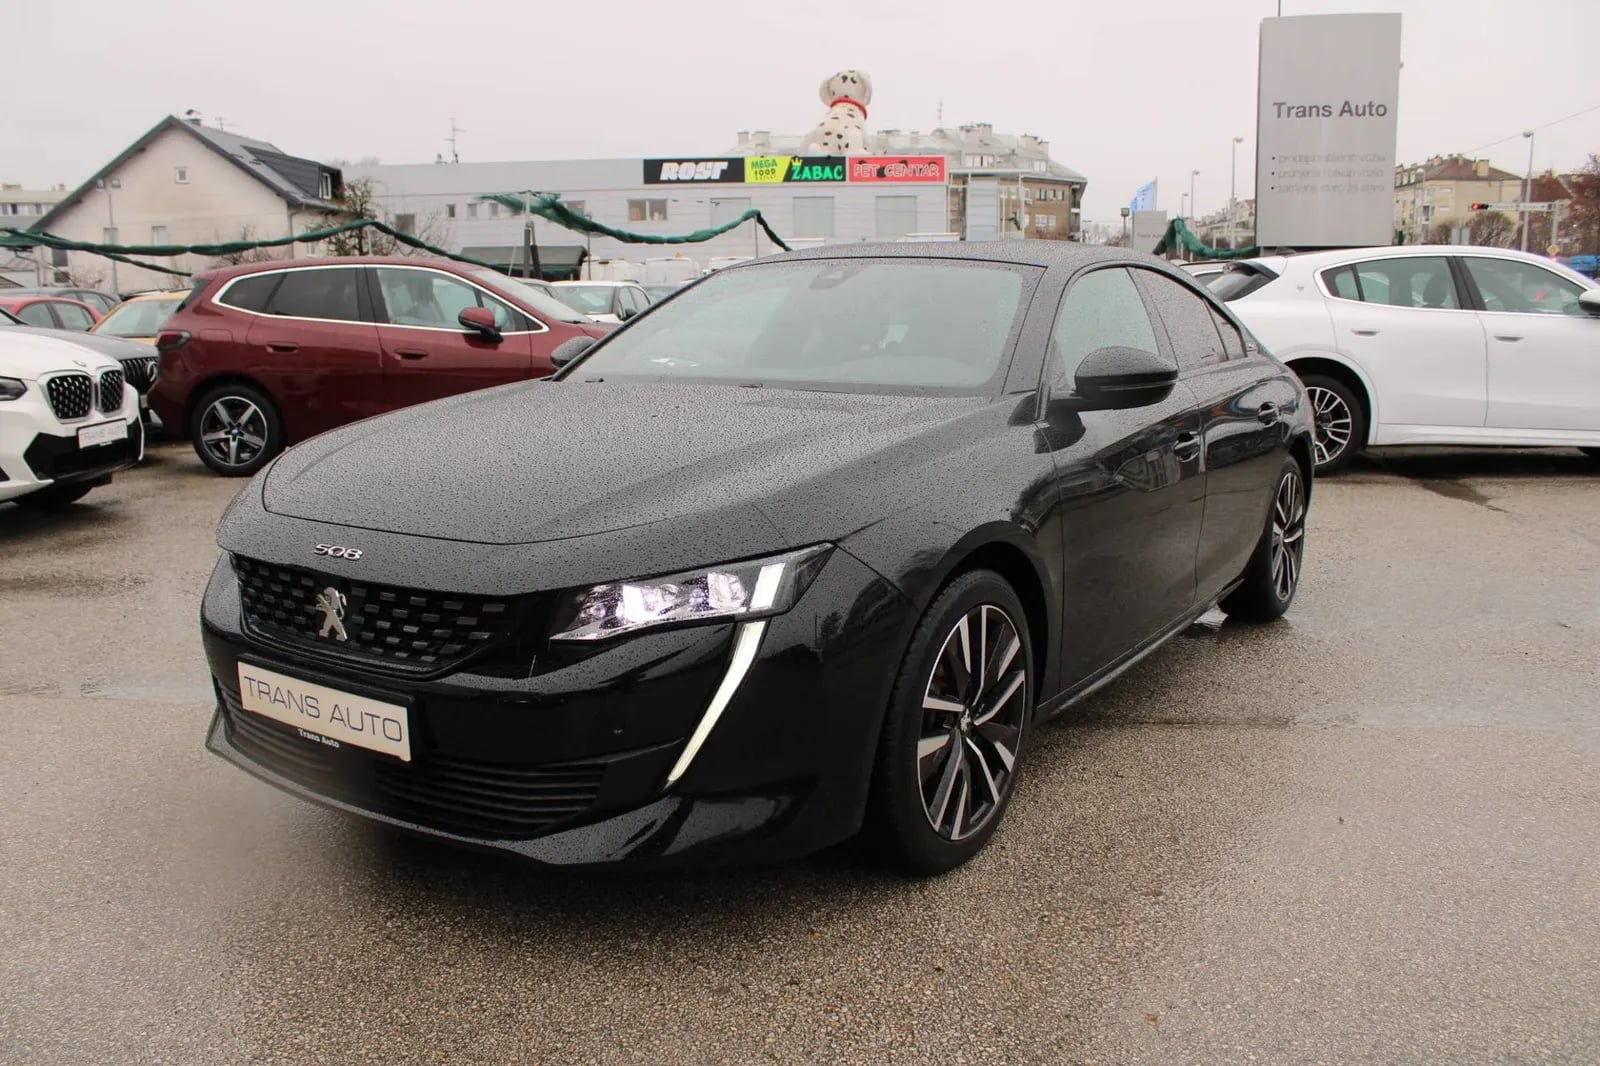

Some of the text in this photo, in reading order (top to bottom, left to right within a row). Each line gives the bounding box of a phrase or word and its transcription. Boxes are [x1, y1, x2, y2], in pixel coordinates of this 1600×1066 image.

[1273, 100, 1387, 118] Trans Auto
[660, 161, 728, 181] ROST
[751, 159, 778, 169] MEGA
[853, 163, 940, 177] PET CENTAR
[313, 543, 363, 561] 508
[244, 675, 403, 743] TRANS AUTO
[297, 728, 340, 748] Trans Auto
